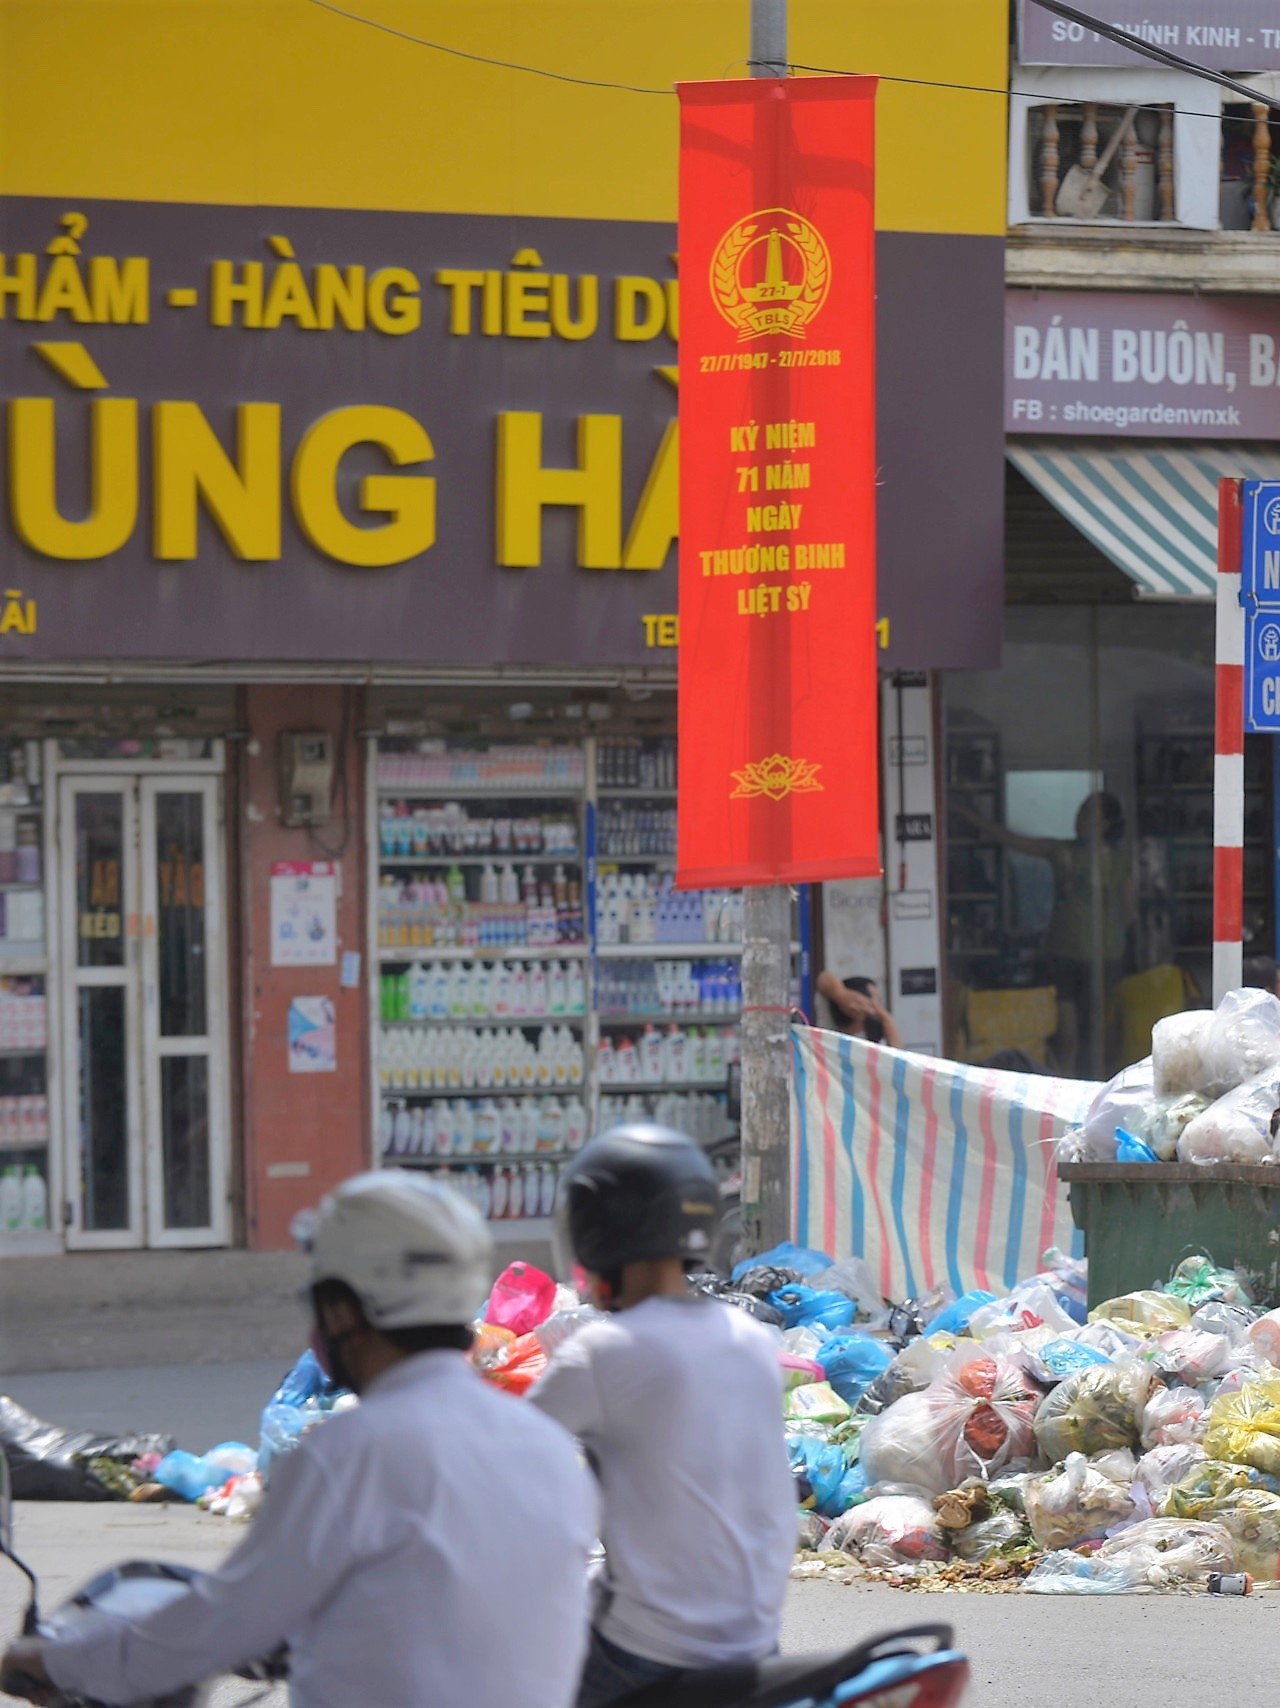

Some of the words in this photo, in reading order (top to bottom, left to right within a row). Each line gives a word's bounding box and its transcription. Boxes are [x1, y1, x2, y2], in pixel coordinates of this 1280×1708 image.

[1186, 26, 1239, 47] KINH
[210, 235, 420, 335] HÀNG
[436, 248, 598, 341] TIÊU
[754, 313, 790, 327] TBLS
[1013, 315, 1099, 381] BÁN
[1112, 319, 1237, 392] BUÔN,
[1012, 399, 1042, 420] FB
[1063, 400, 1240, 428] shoegardenvnxk
[730, 420, 758, 452] KỶ
[766, 420, 816, 453] NIỆM
[737, 467, 758, 492] 71
[766, 460, 811, 489] NĂM
[747, 501, 802, 532] NGÀY
[700, 544, 790, 576] THƯƠNG
[795, 543, 846, 570] BINH
[738, 584, 781, 618] LIỆT
